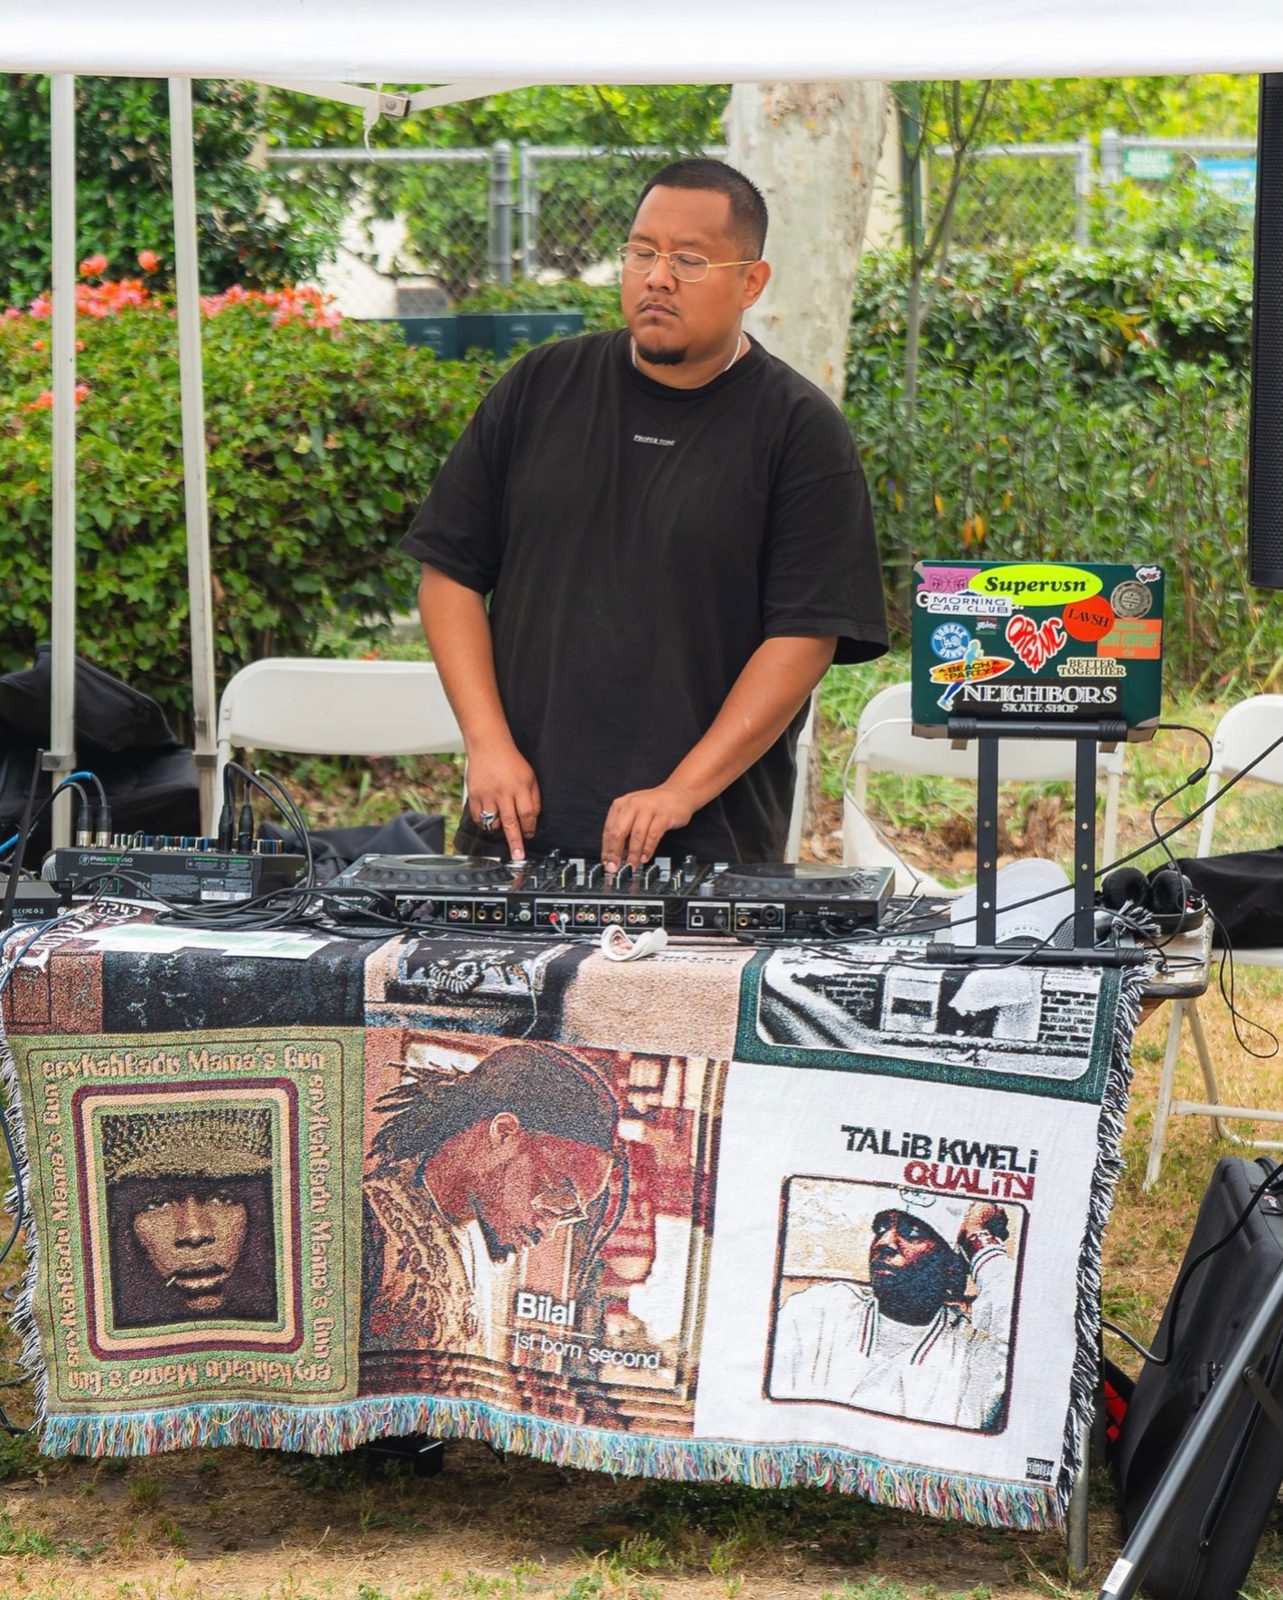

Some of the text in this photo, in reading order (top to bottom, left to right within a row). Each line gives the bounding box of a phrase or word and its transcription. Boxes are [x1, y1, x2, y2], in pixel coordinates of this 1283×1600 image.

[984, 576, 1087, 597] Supervsn
[933, 596, 1006, 607] MORNING
[929, 603, 960, 612] CAR
[967, 605, 1009, 614] CLUB
[1007, 616, 1066, 672] ORGANIC
[948, 661, 990, 672] BEACH
[1069, 659, 1115, 669] BETTER
[948, 669, 990, 679] PARTY
[1059, 667, 1124, 676] TOGETHER
[962, 685, 1118, 704] NEIGHBORS
[1001, 704, 1079, 713] SKATE SHOP
[516, 1292, 576, 1326] Bilal
[512, 1331, 661, 1369] 1st born second
